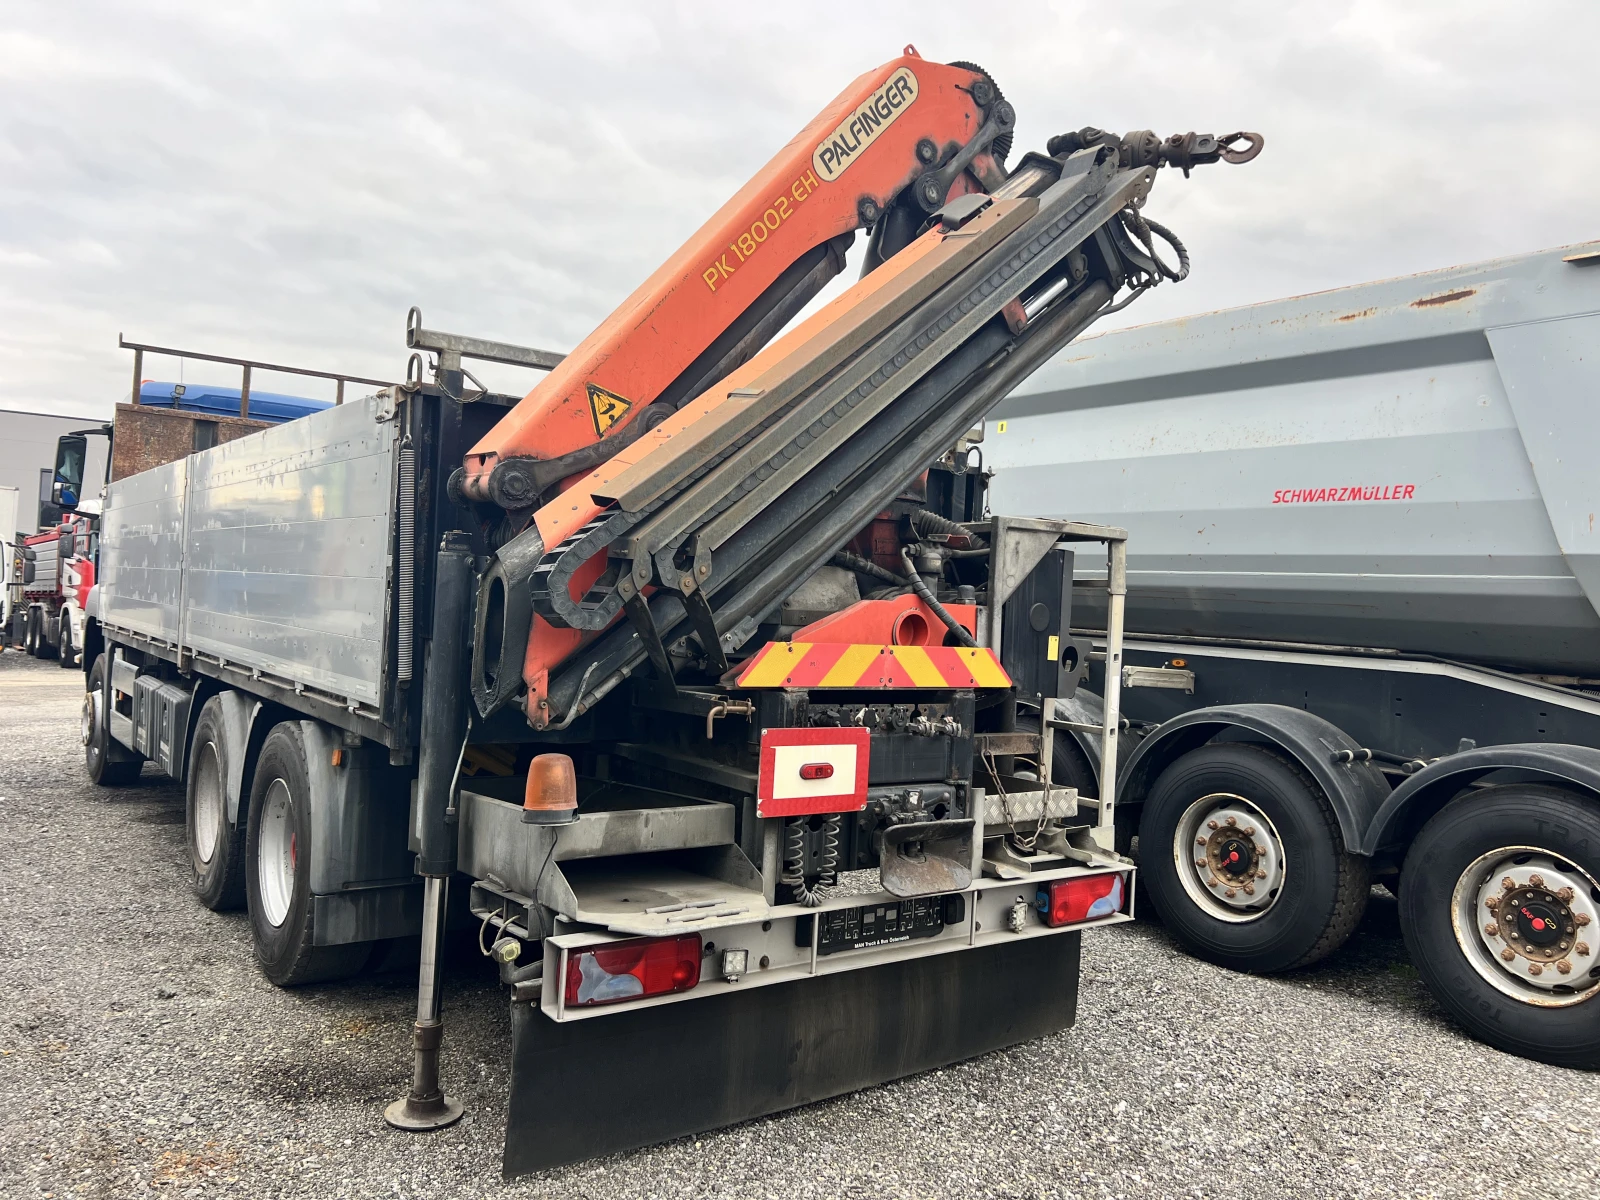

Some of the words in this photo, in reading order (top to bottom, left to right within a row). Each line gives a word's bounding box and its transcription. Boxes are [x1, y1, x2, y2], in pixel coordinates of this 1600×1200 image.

[818, 75, 914, 174] PALFINGER
[702, 253, 736, 292] PK
[1272, 484, 1415, 503] SCHWARZMÜLLER
[1520, 907, 1535, 920] SAF
